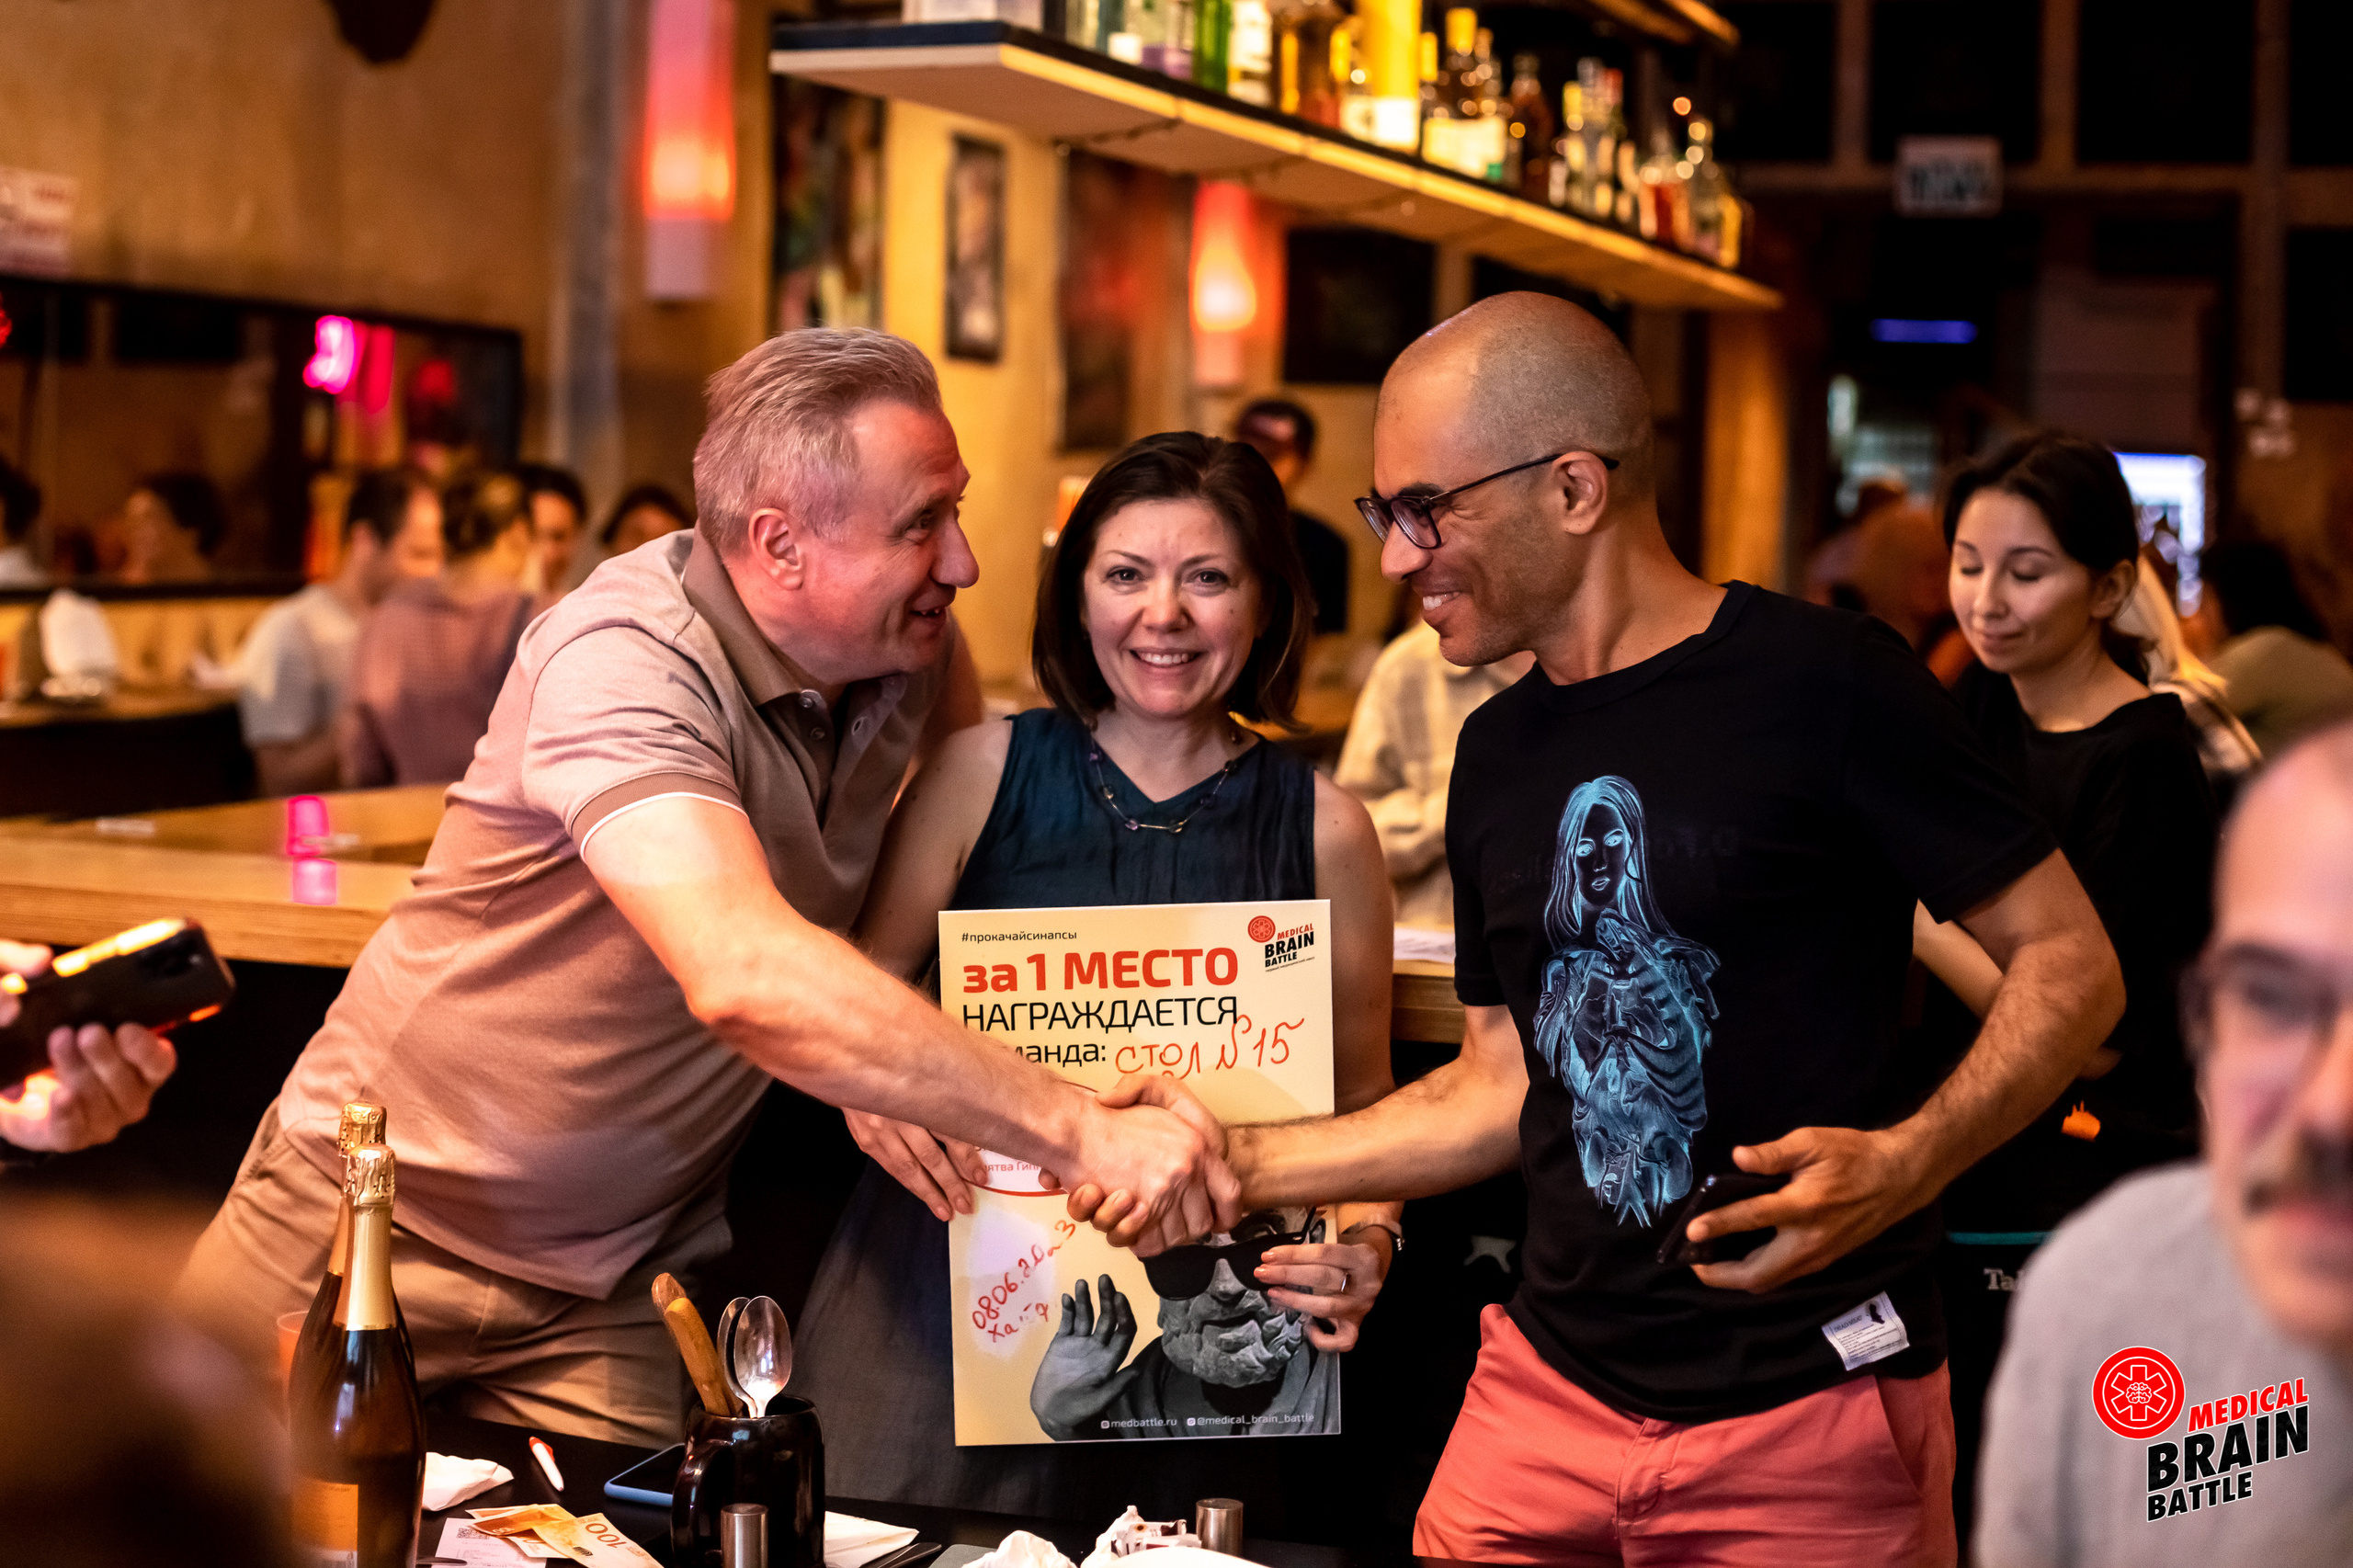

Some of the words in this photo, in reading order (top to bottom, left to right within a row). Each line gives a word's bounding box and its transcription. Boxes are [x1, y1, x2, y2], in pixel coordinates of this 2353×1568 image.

[961, 931, 1078, 945] #прокачайсинапсы
[1277, 923, 1314, 940] MEDICAL
[1265, 930, 1315, 959] BRAIN
[1265, 950, 1298, 968] BATTLE
[963, 963, 1017, 994] за
[1026, 953, 1047, 992] 1
[1063, 947, 1239, 991] МЕСТО
[962, 995, 1238, 1035] НАГРАЖДАЕТСЯ
[1015, 1043, 1107, 1068] анда:
[984, 1163, 1014, 1172] ятва
[1110, 1417, 1177, 1429] medbattle.ru
